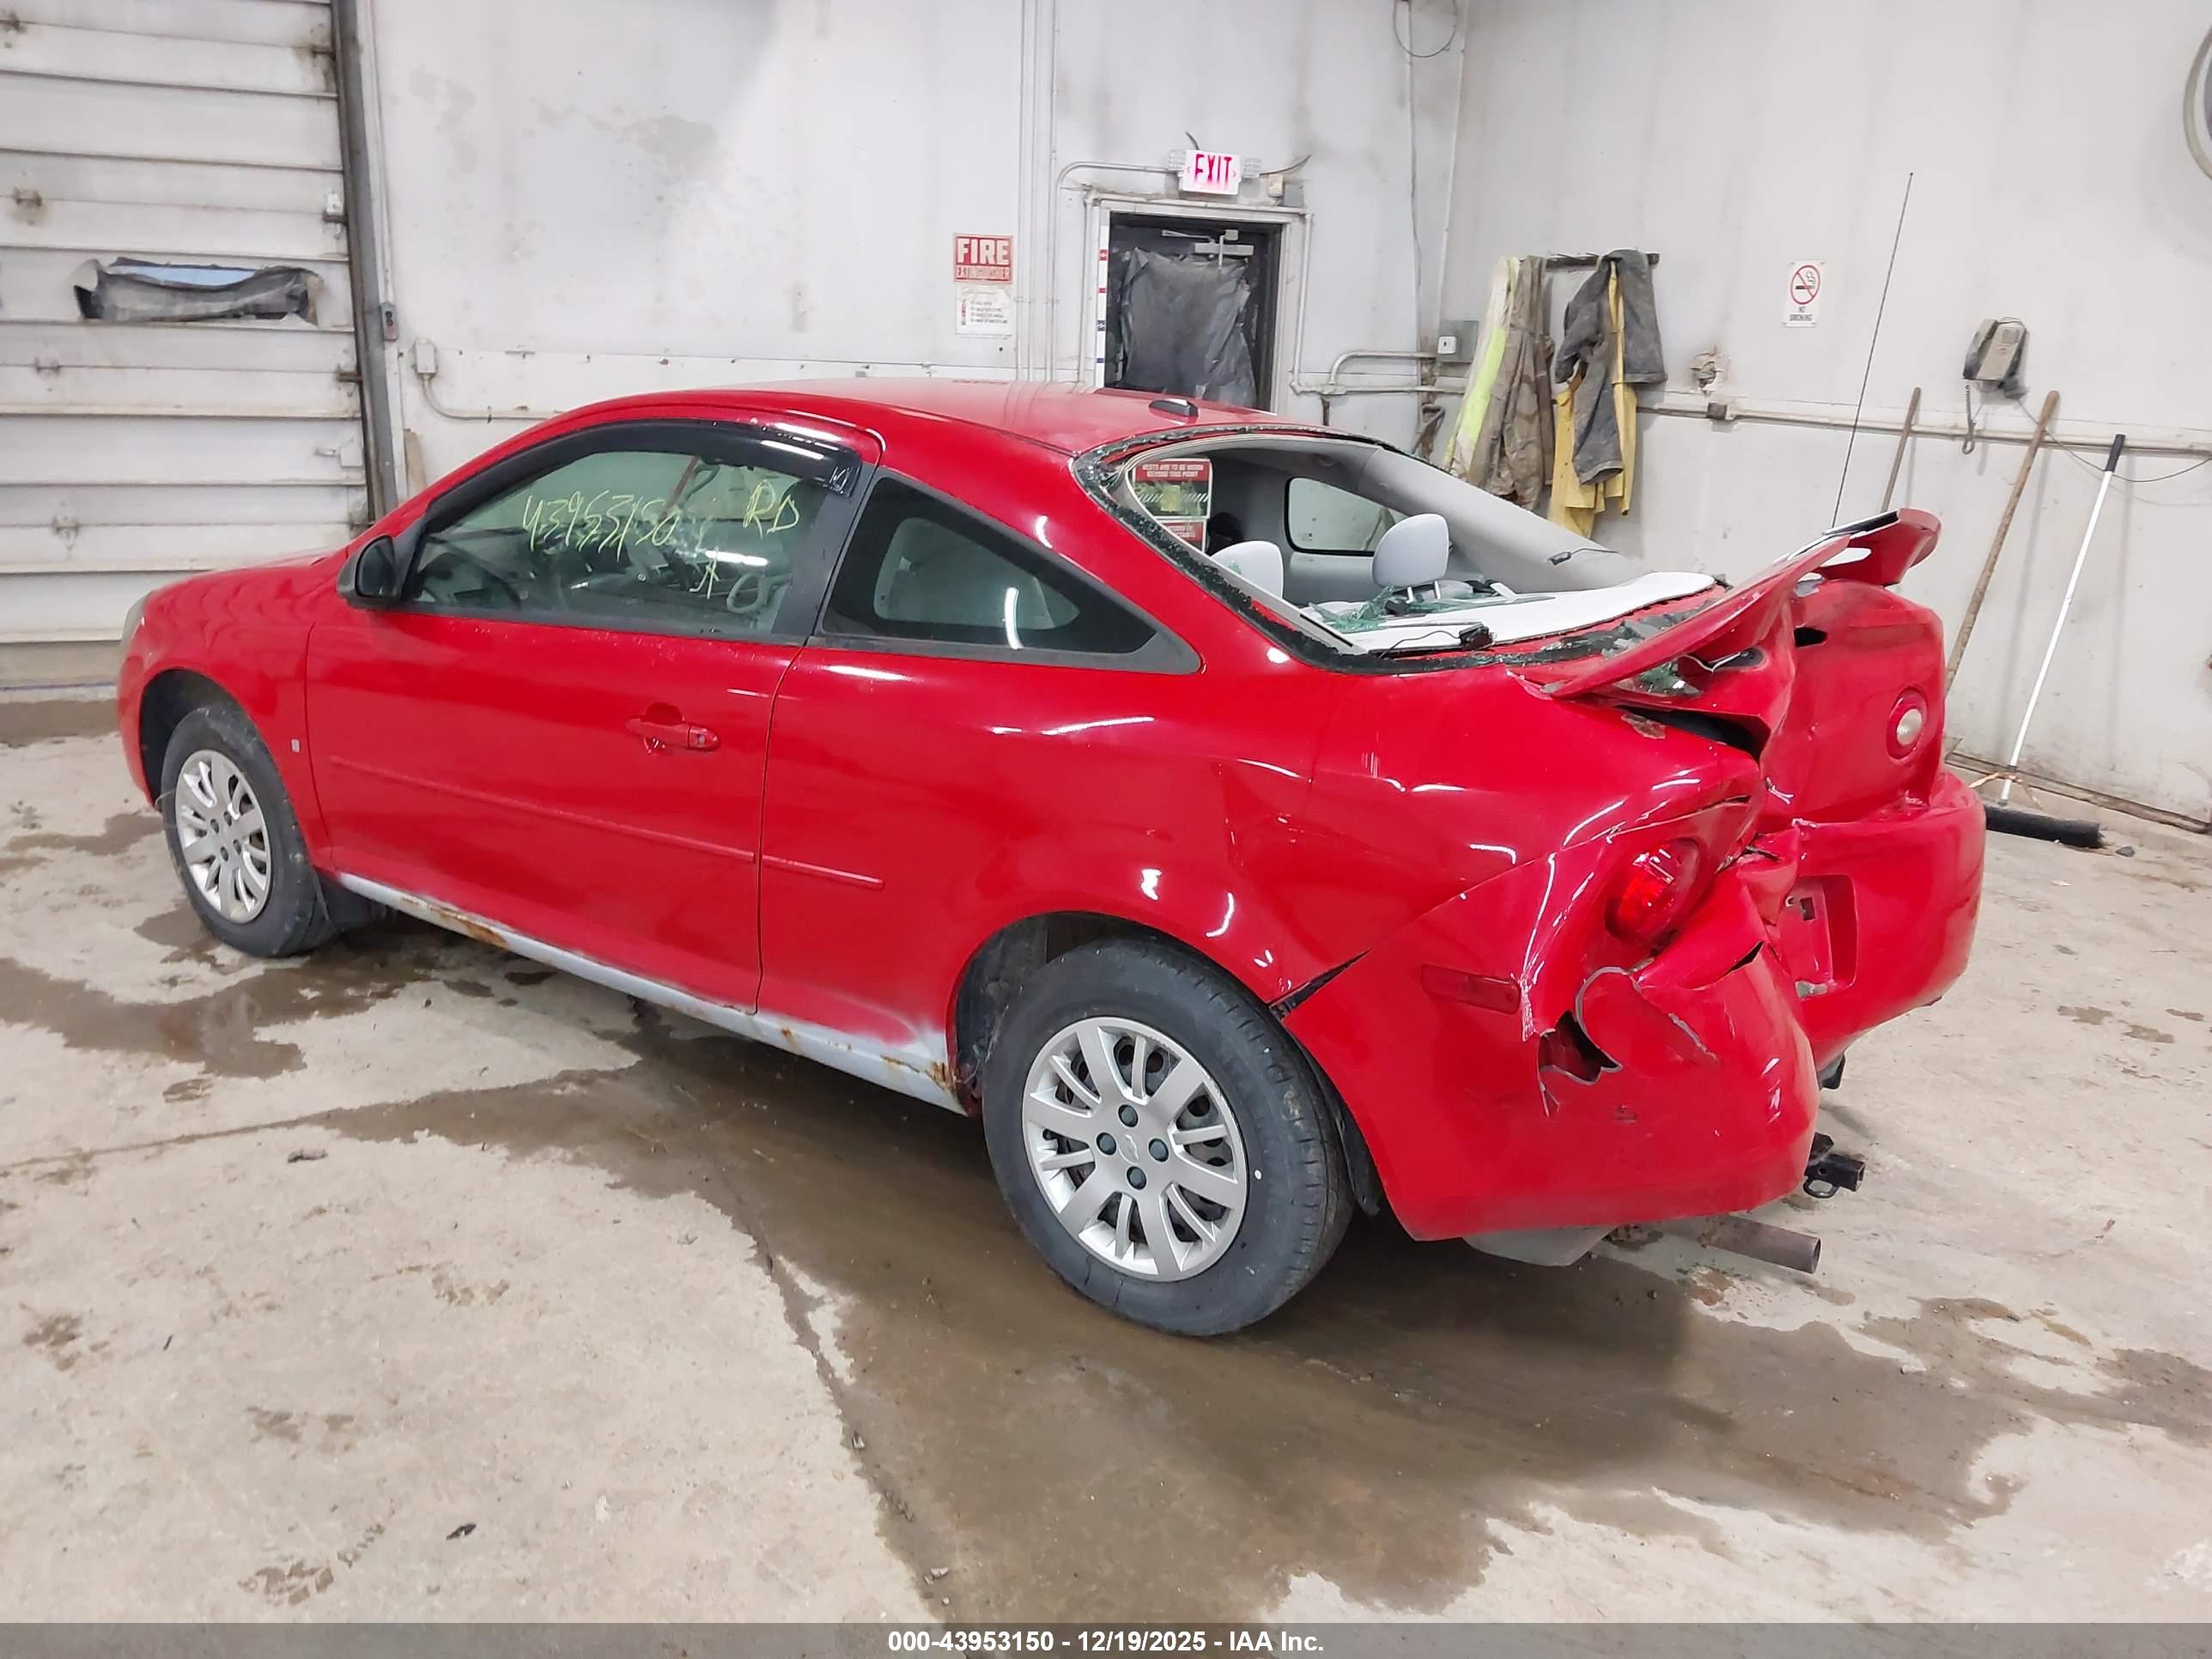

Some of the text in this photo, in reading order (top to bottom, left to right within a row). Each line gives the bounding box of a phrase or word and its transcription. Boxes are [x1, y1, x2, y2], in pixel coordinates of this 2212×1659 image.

[1194, 153, 1232, 184] EXIT
[957, 238, 1011, 265] FIRE
[522, 489, 682, 563] 43953150
